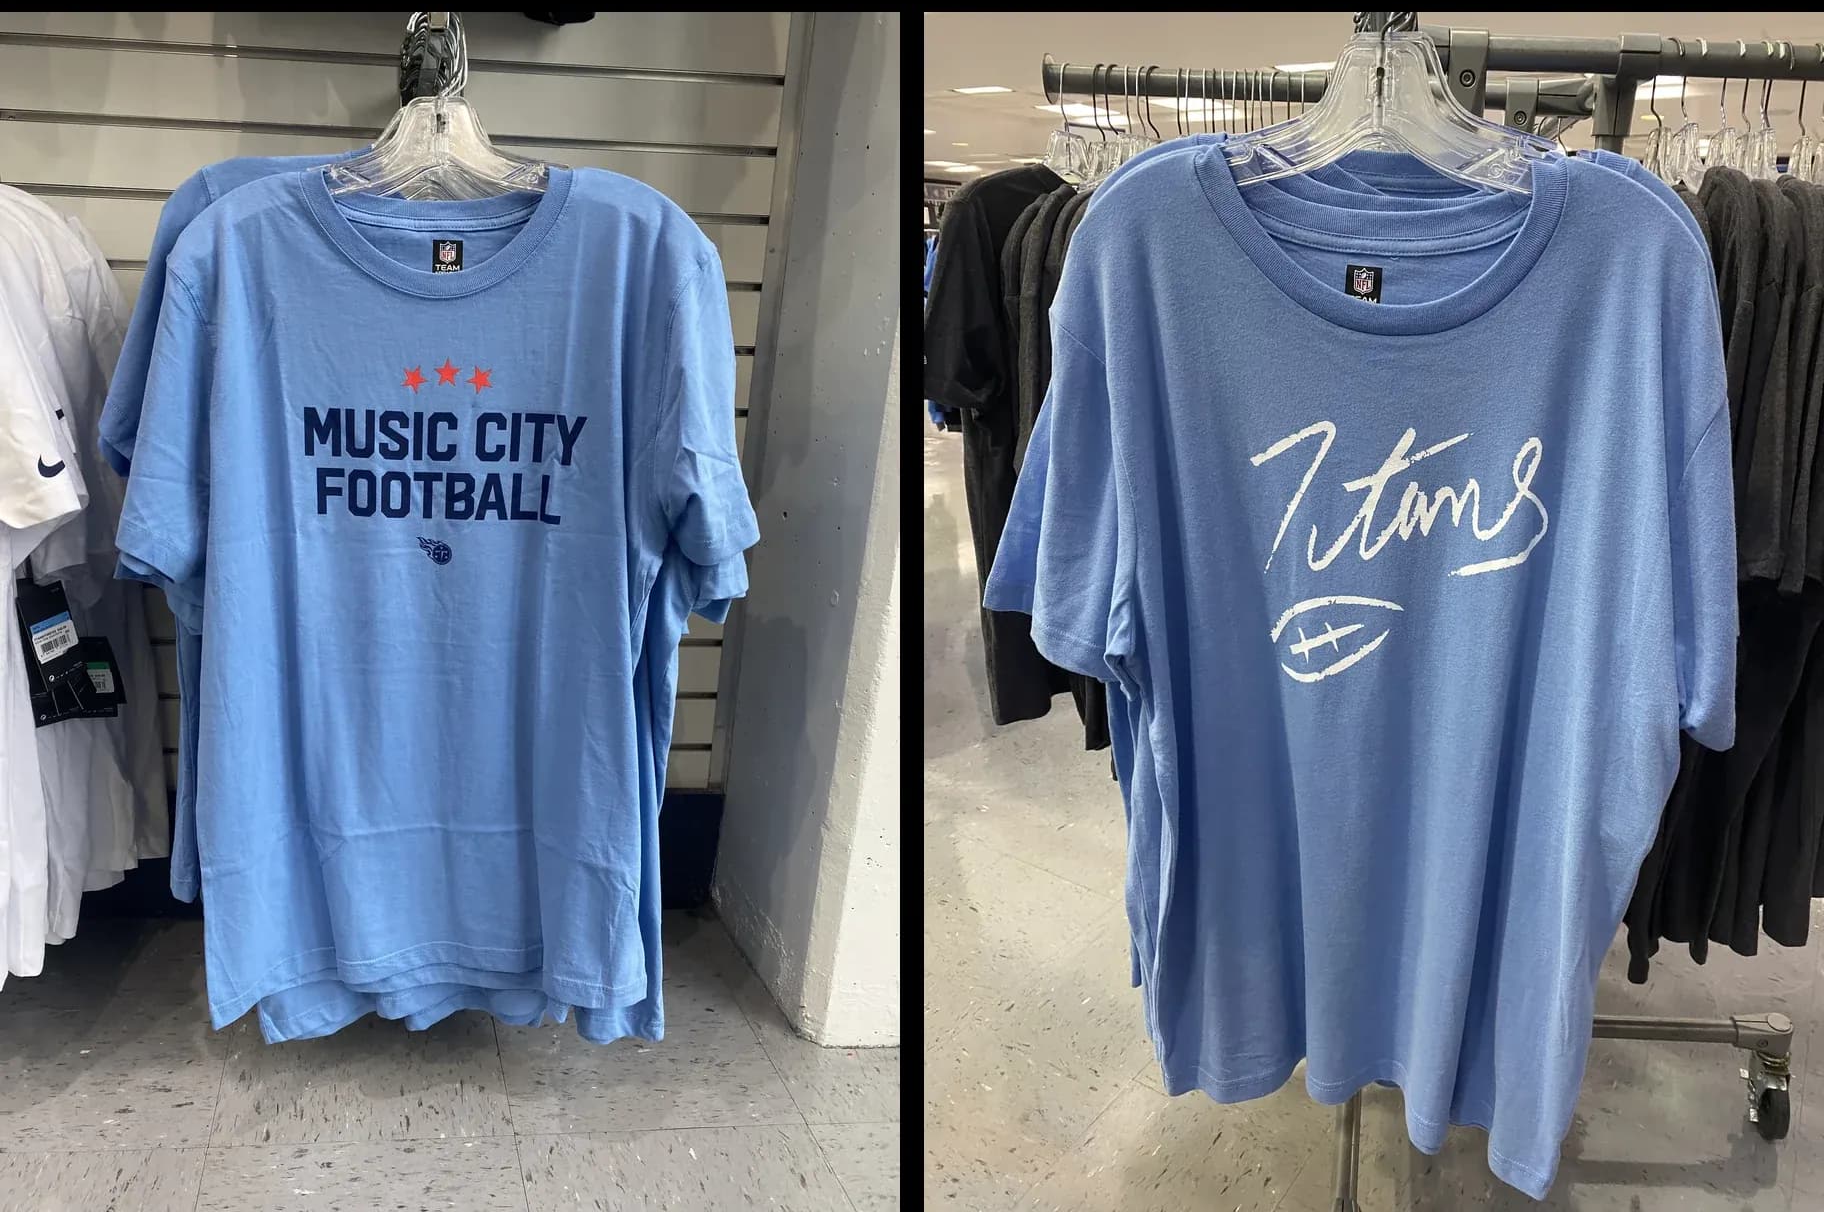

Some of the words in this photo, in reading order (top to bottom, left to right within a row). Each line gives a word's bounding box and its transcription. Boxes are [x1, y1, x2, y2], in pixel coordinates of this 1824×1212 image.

[1356, 279, 1371, 290] NFL
[303, 406, 459, 462] MUSIC
[475, 412, 588, 466] CITY
[316, 467, 562, 525] FOOTBALL
[1249, 421, 1548, 577] Titans
